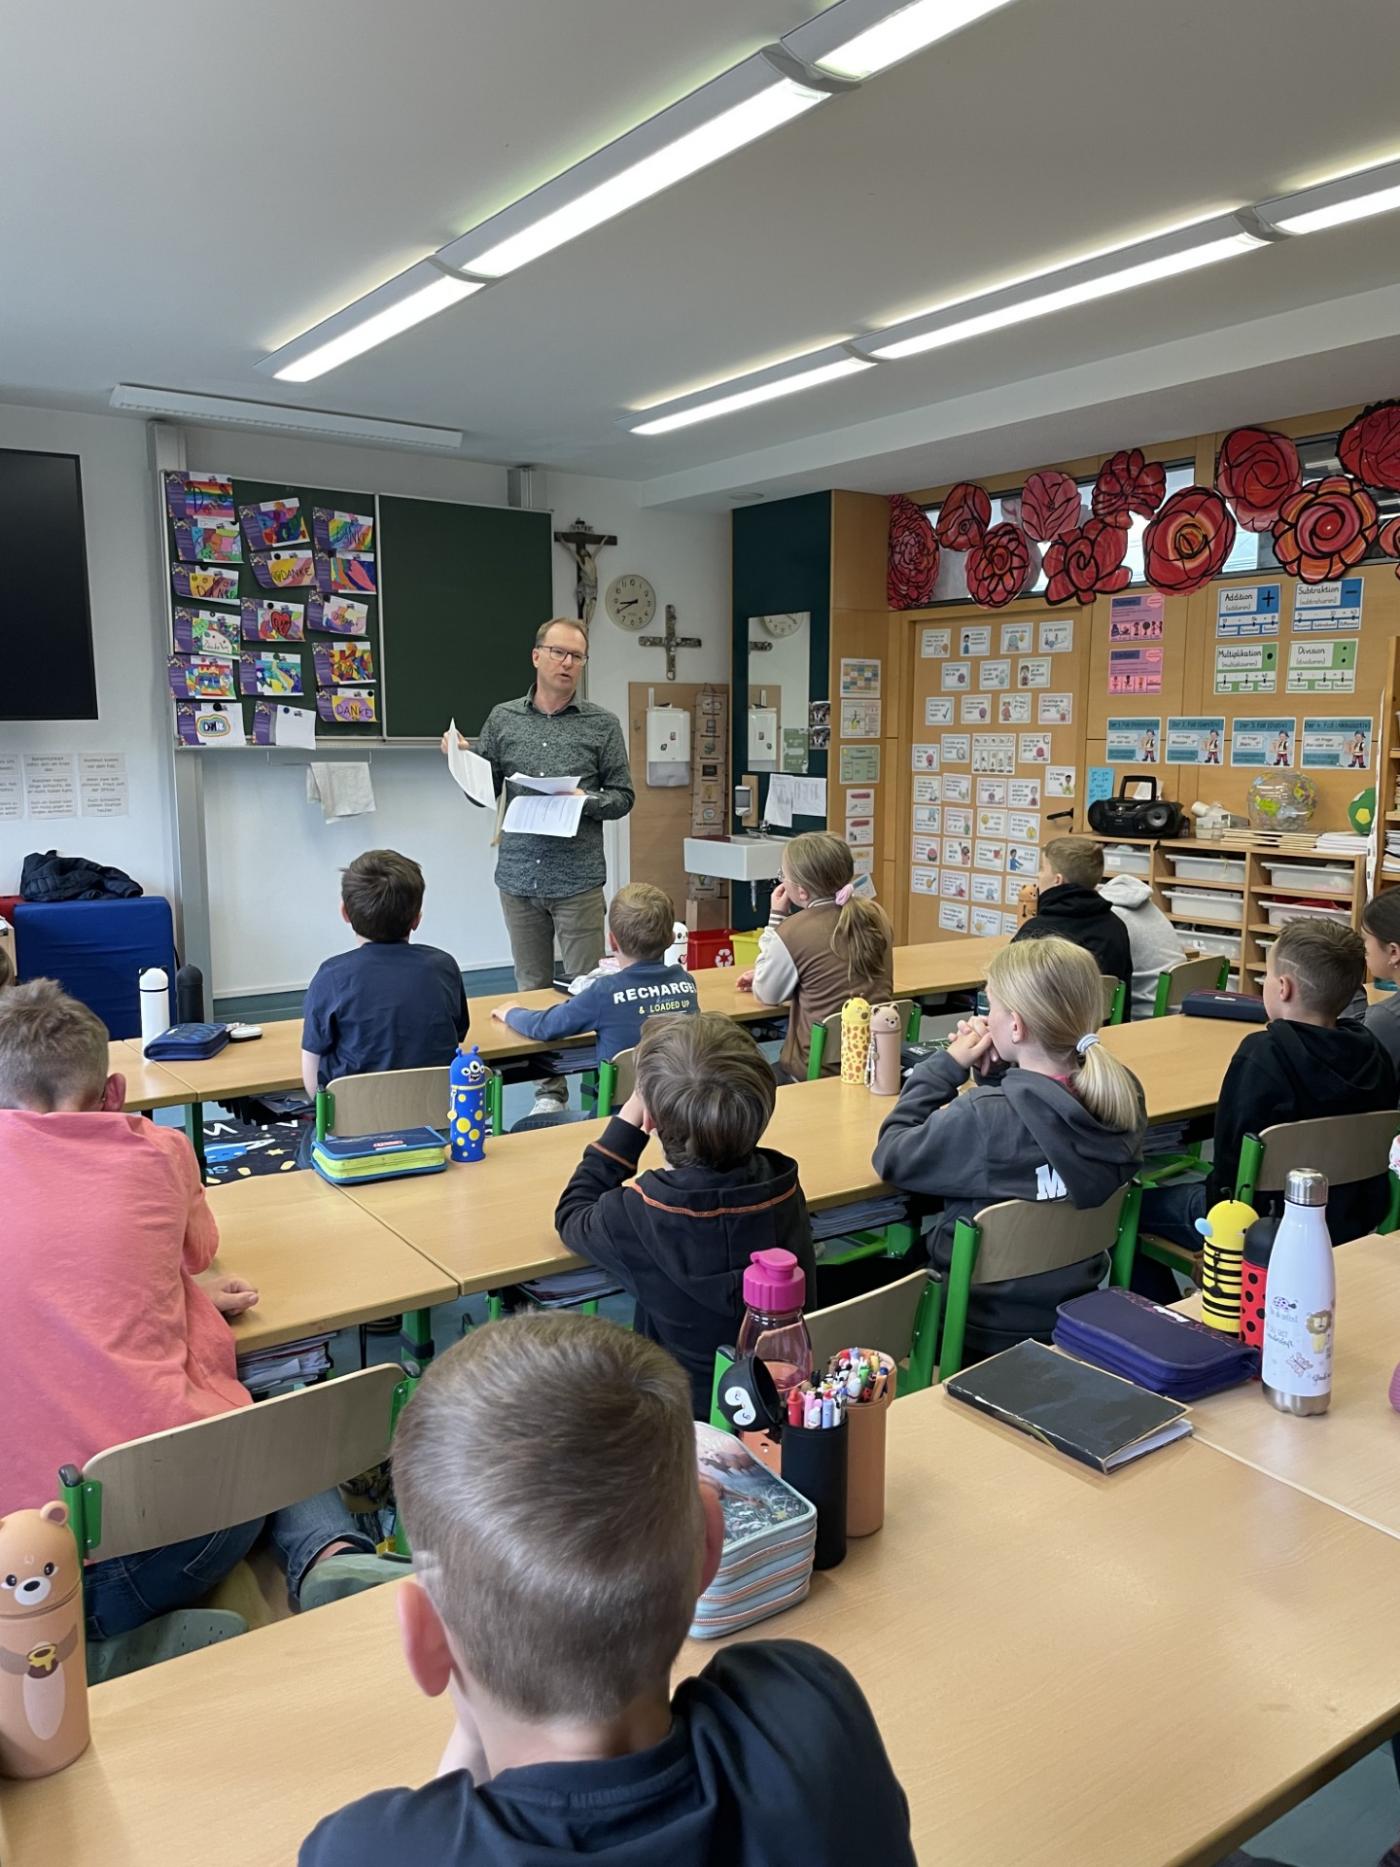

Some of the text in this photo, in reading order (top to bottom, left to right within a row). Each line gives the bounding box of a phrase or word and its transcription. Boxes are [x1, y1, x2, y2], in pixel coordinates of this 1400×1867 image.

[1298, 584, 1340, 595] Subtraktion
[1224, 592, 1253, 602] Addition
[1218, 649, 1262, 659] Multiplikation
[1297, 645, 1325, 655] Division
[638, 1005, 645, 1015] &
[649, 1000, 680, 1013] LOADED
[681, 999, 690, 1008] UP
